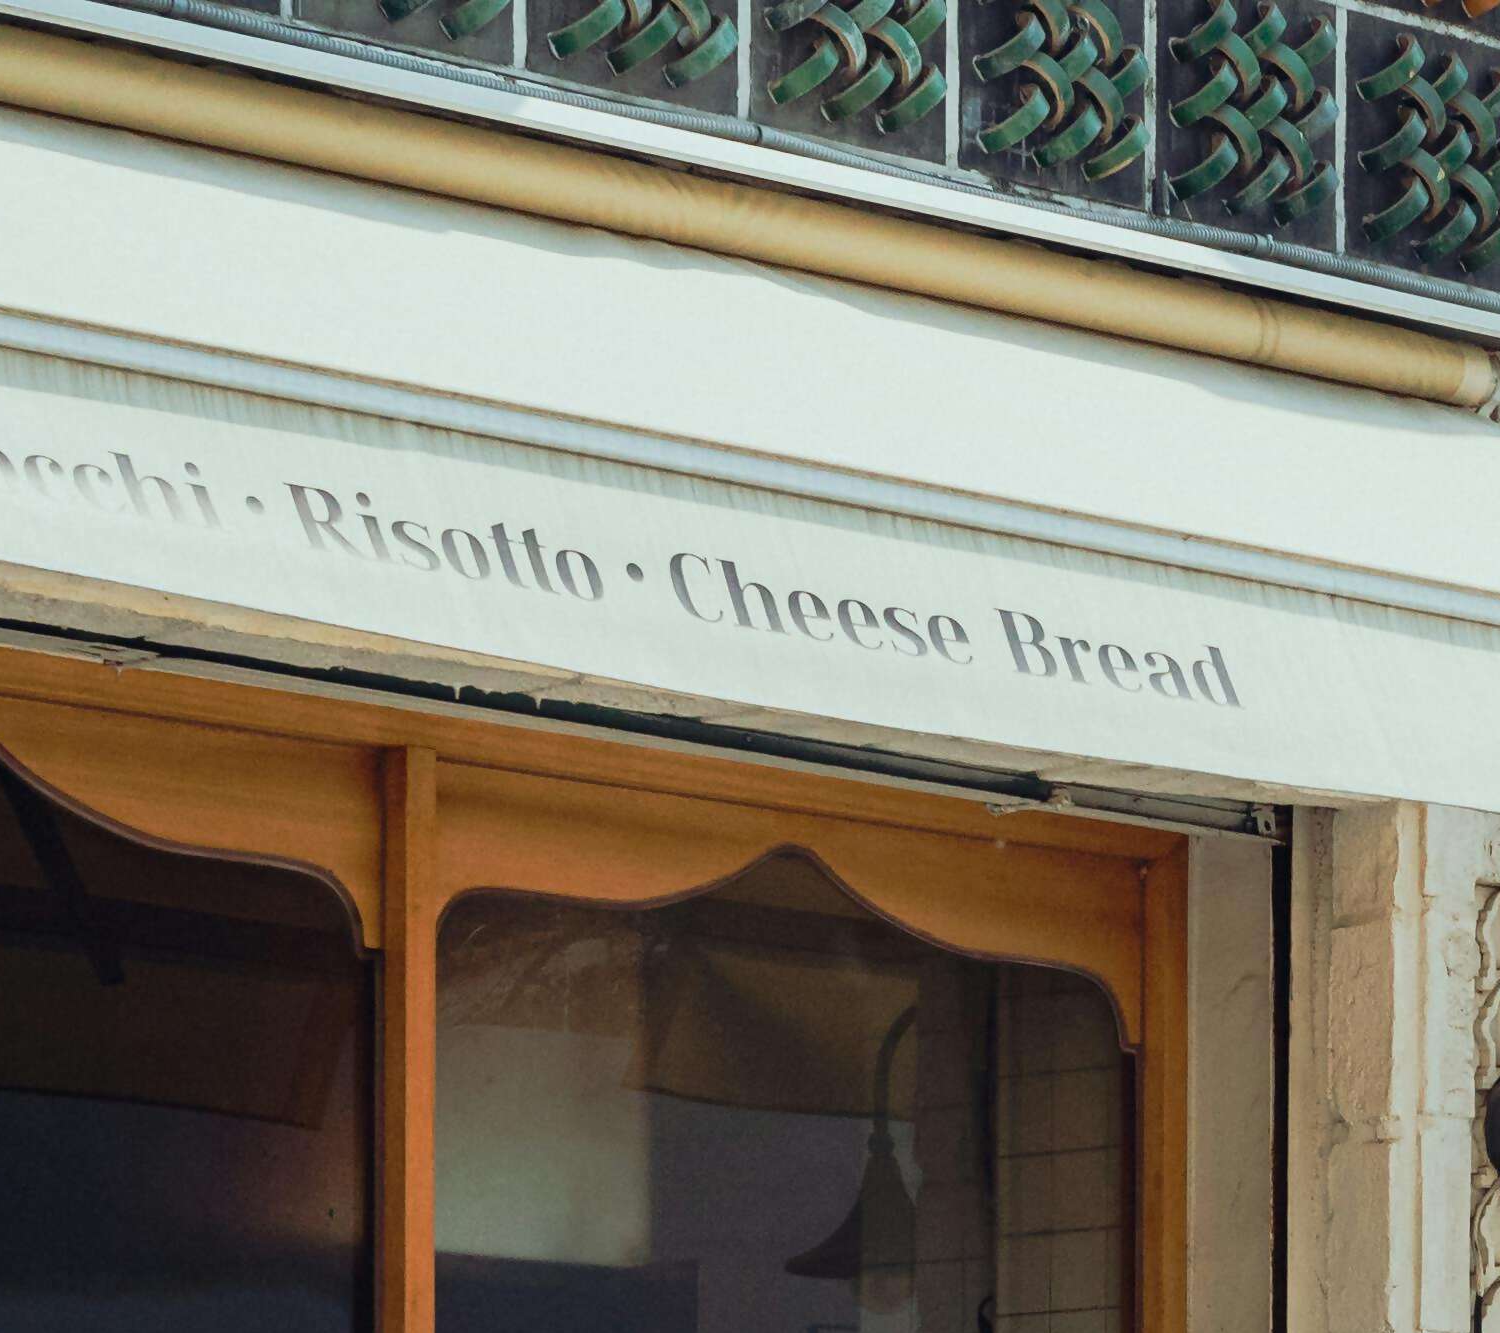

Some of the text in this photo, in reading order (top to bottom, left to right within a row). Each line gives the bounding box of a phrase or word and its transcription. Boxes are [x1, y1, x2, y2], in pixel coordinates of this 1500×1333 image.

[283, 480, 607, 603] Risotto
[667, 549, 976, 667] Cheese
[993, 604, 1243, 709] Bread
